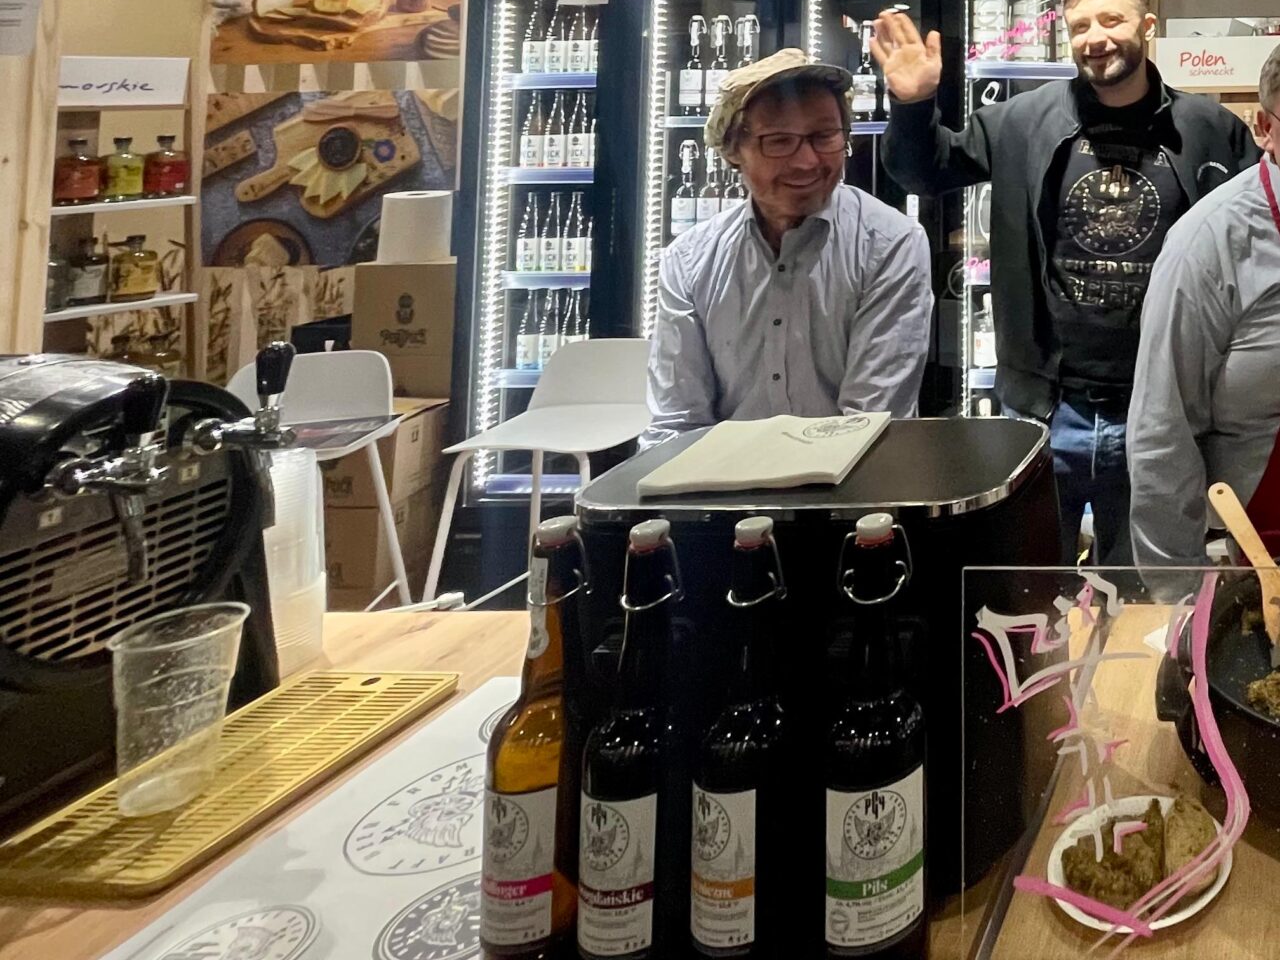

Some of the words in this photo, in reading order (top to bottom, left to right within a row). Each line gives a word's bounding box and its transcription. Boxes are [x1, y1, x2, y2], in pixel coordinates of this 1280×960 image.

[1179, 49, 1227, 69] Polen
[1188, 65, 1236, 77] schmeckt
[861, 880, 889, 898] Pils
